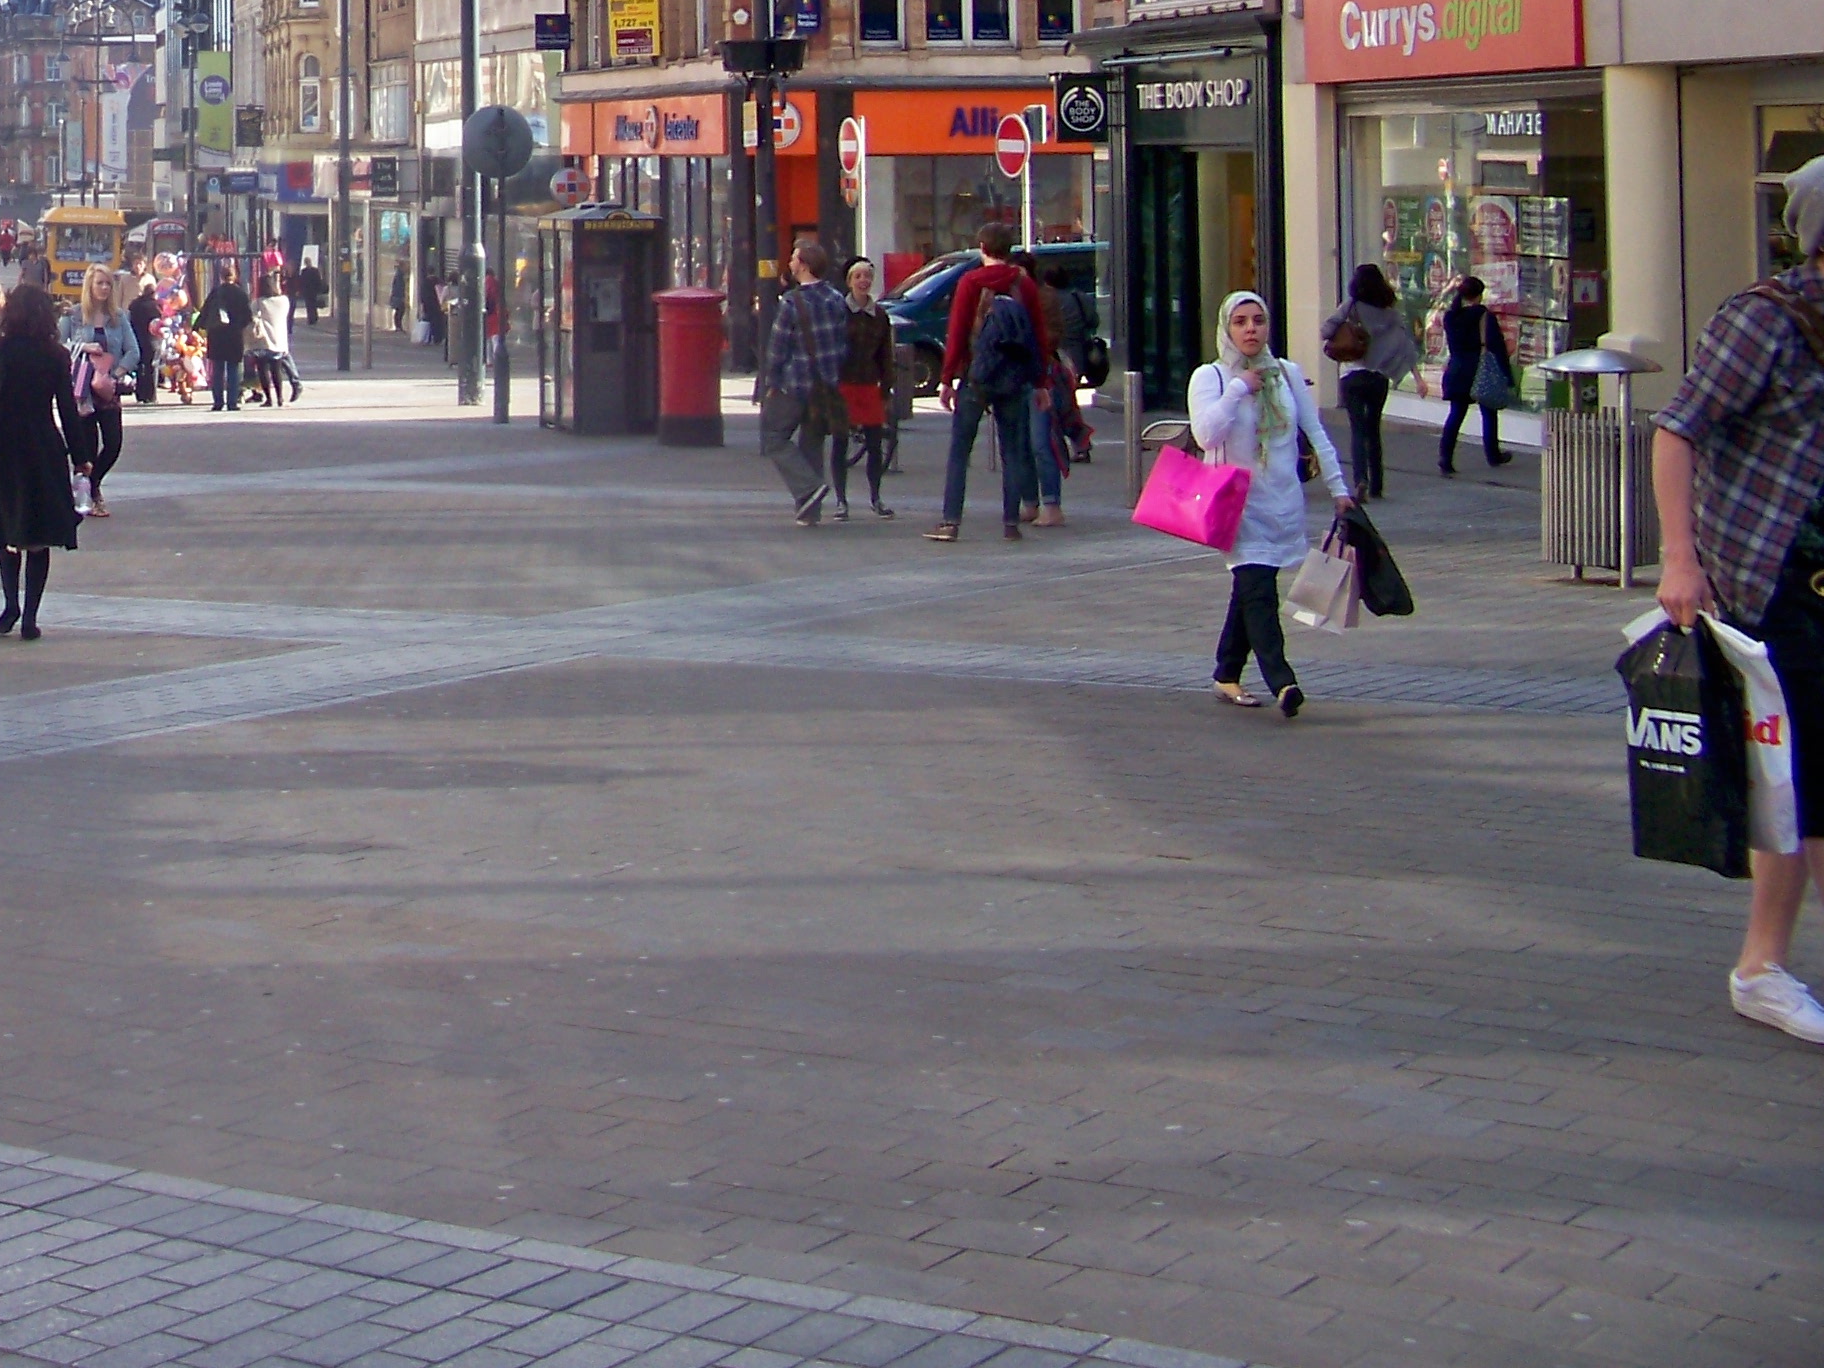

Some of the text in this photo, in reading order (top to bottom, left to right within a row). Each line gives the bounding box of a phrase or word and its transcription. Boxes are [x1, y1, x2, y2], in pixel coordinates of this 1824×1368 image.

[1137, 79, 1246, 110] THE BODY SHOP
[1074, 99, 1091, 107] THE
[1069, 107, 1095, 115] BODY
[1071, 115, 1095, 123] SHOP
[1626, 705, 1702, 755] VANS
